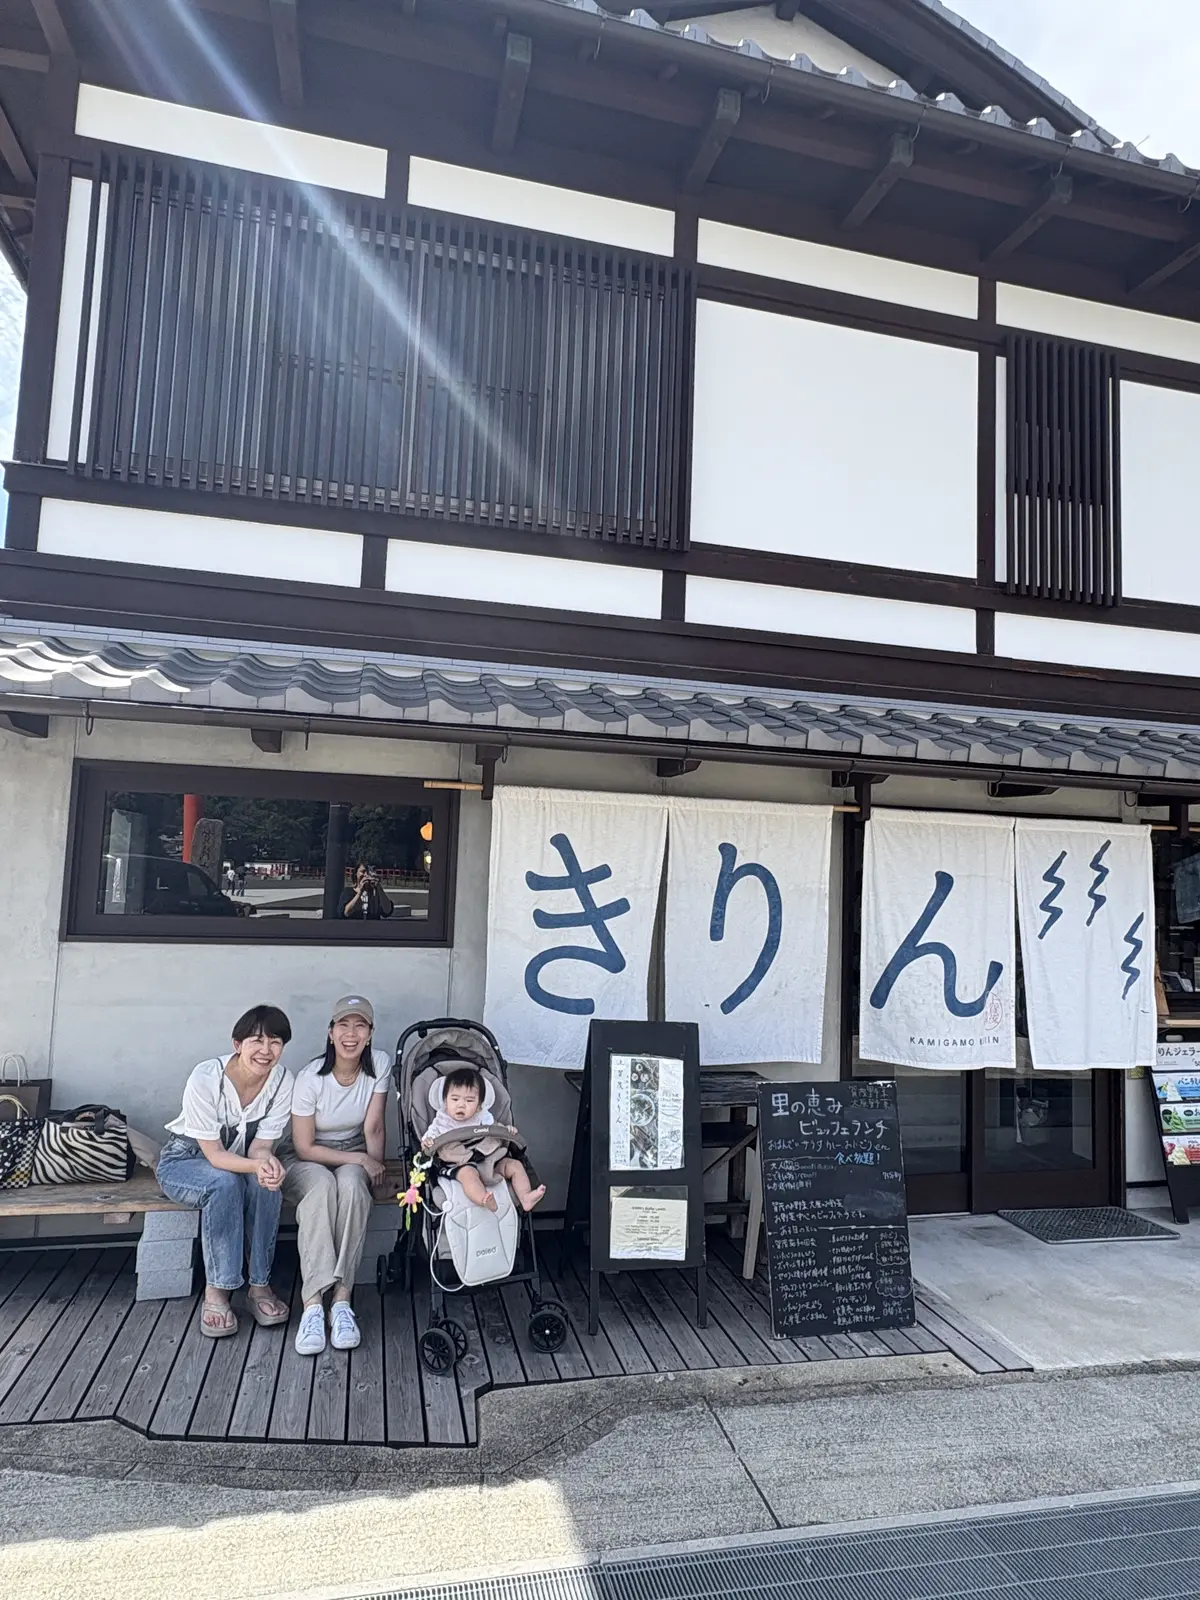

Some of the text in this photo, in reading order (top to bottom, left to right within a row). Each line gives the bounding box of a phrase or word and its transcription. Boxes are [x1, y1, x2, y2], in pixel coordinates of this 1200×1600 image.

[909, 1036, 975, 1047] KAMIGAMO
[772, 1087, 843, 1117] 里の恵み
[799, 1119, 890, 1139] ビュッフェランチ
